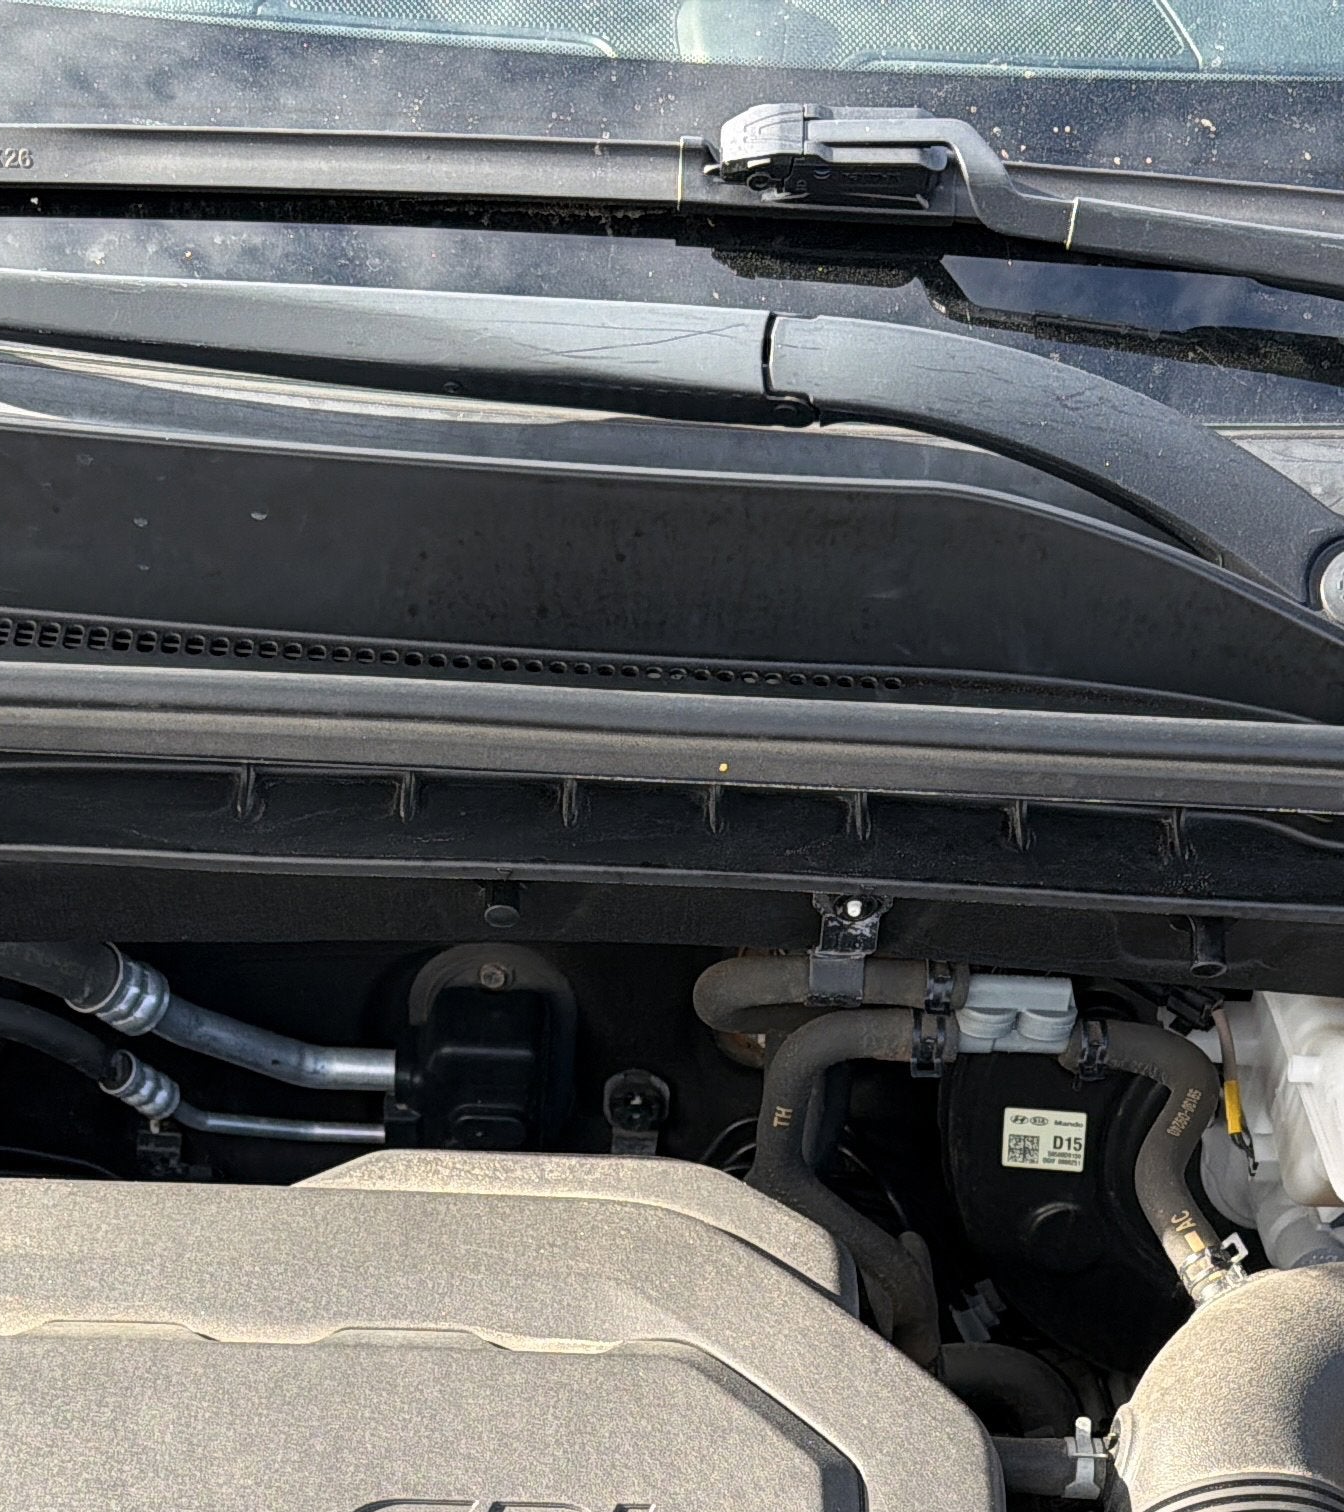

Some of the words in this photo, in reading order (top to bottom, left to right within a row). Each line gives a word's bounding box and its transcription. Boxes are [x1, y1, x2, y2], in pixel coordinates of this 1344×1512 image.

[5, 148, 34, 168] 26
[773, 1106, 793, 1127] TH
[1053, 1135, 1083, 1152] D15
[1170, 1210, 1197, 1232] AC
